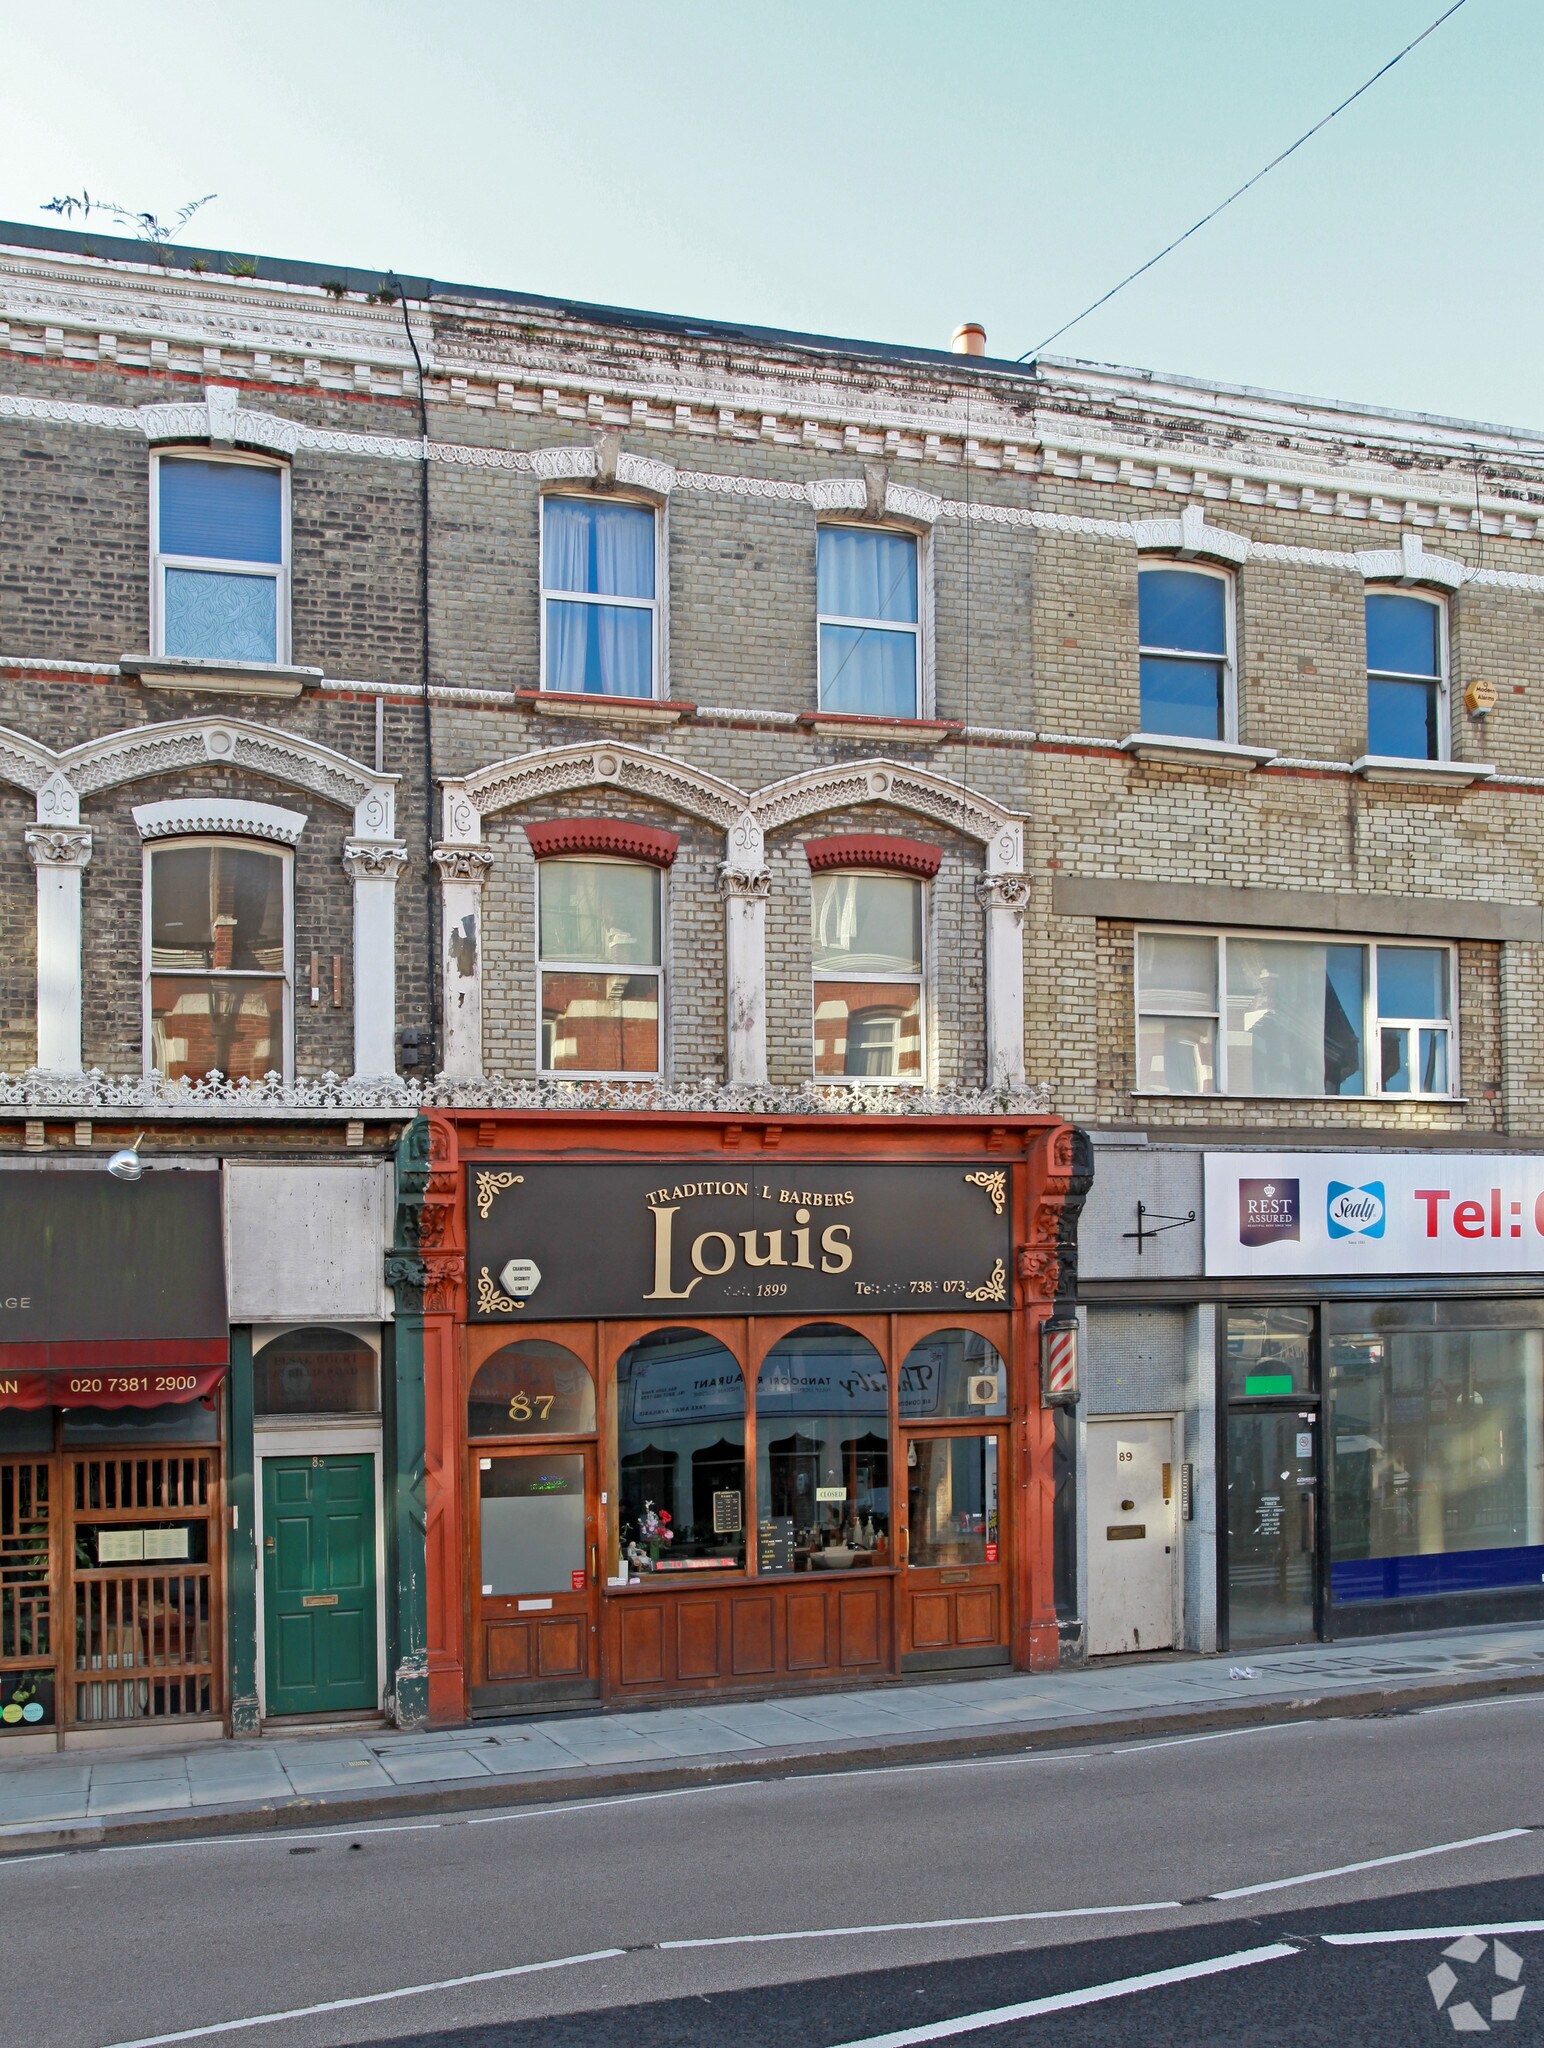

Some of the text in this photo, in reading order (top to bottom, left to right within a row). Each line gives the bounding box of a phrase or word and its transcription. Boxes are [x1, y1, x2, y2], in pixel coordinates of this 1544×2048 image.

[646, 1181, 855, 1207] TRADITIONL BARBERS
[1247, 1199, 1293, 1214] REST
[1334, 1197, 1375, 1222] Sealy
[1414, 1188, 1521, 1239] Tel:
[1247, 1214, 1293, 1223] ASSURED
[643, 1206, 853, 1299] Louis
[756, 1284, 788, 1297] 1899
[70, 1379, 102, 1392] 020
[108, 1377, 149, 1392] 7381
[155, 1376, 197, 1391] 2900
[508, 1390, 556, 1421] 87
[1119, 1451, 1133, 1462] 89
